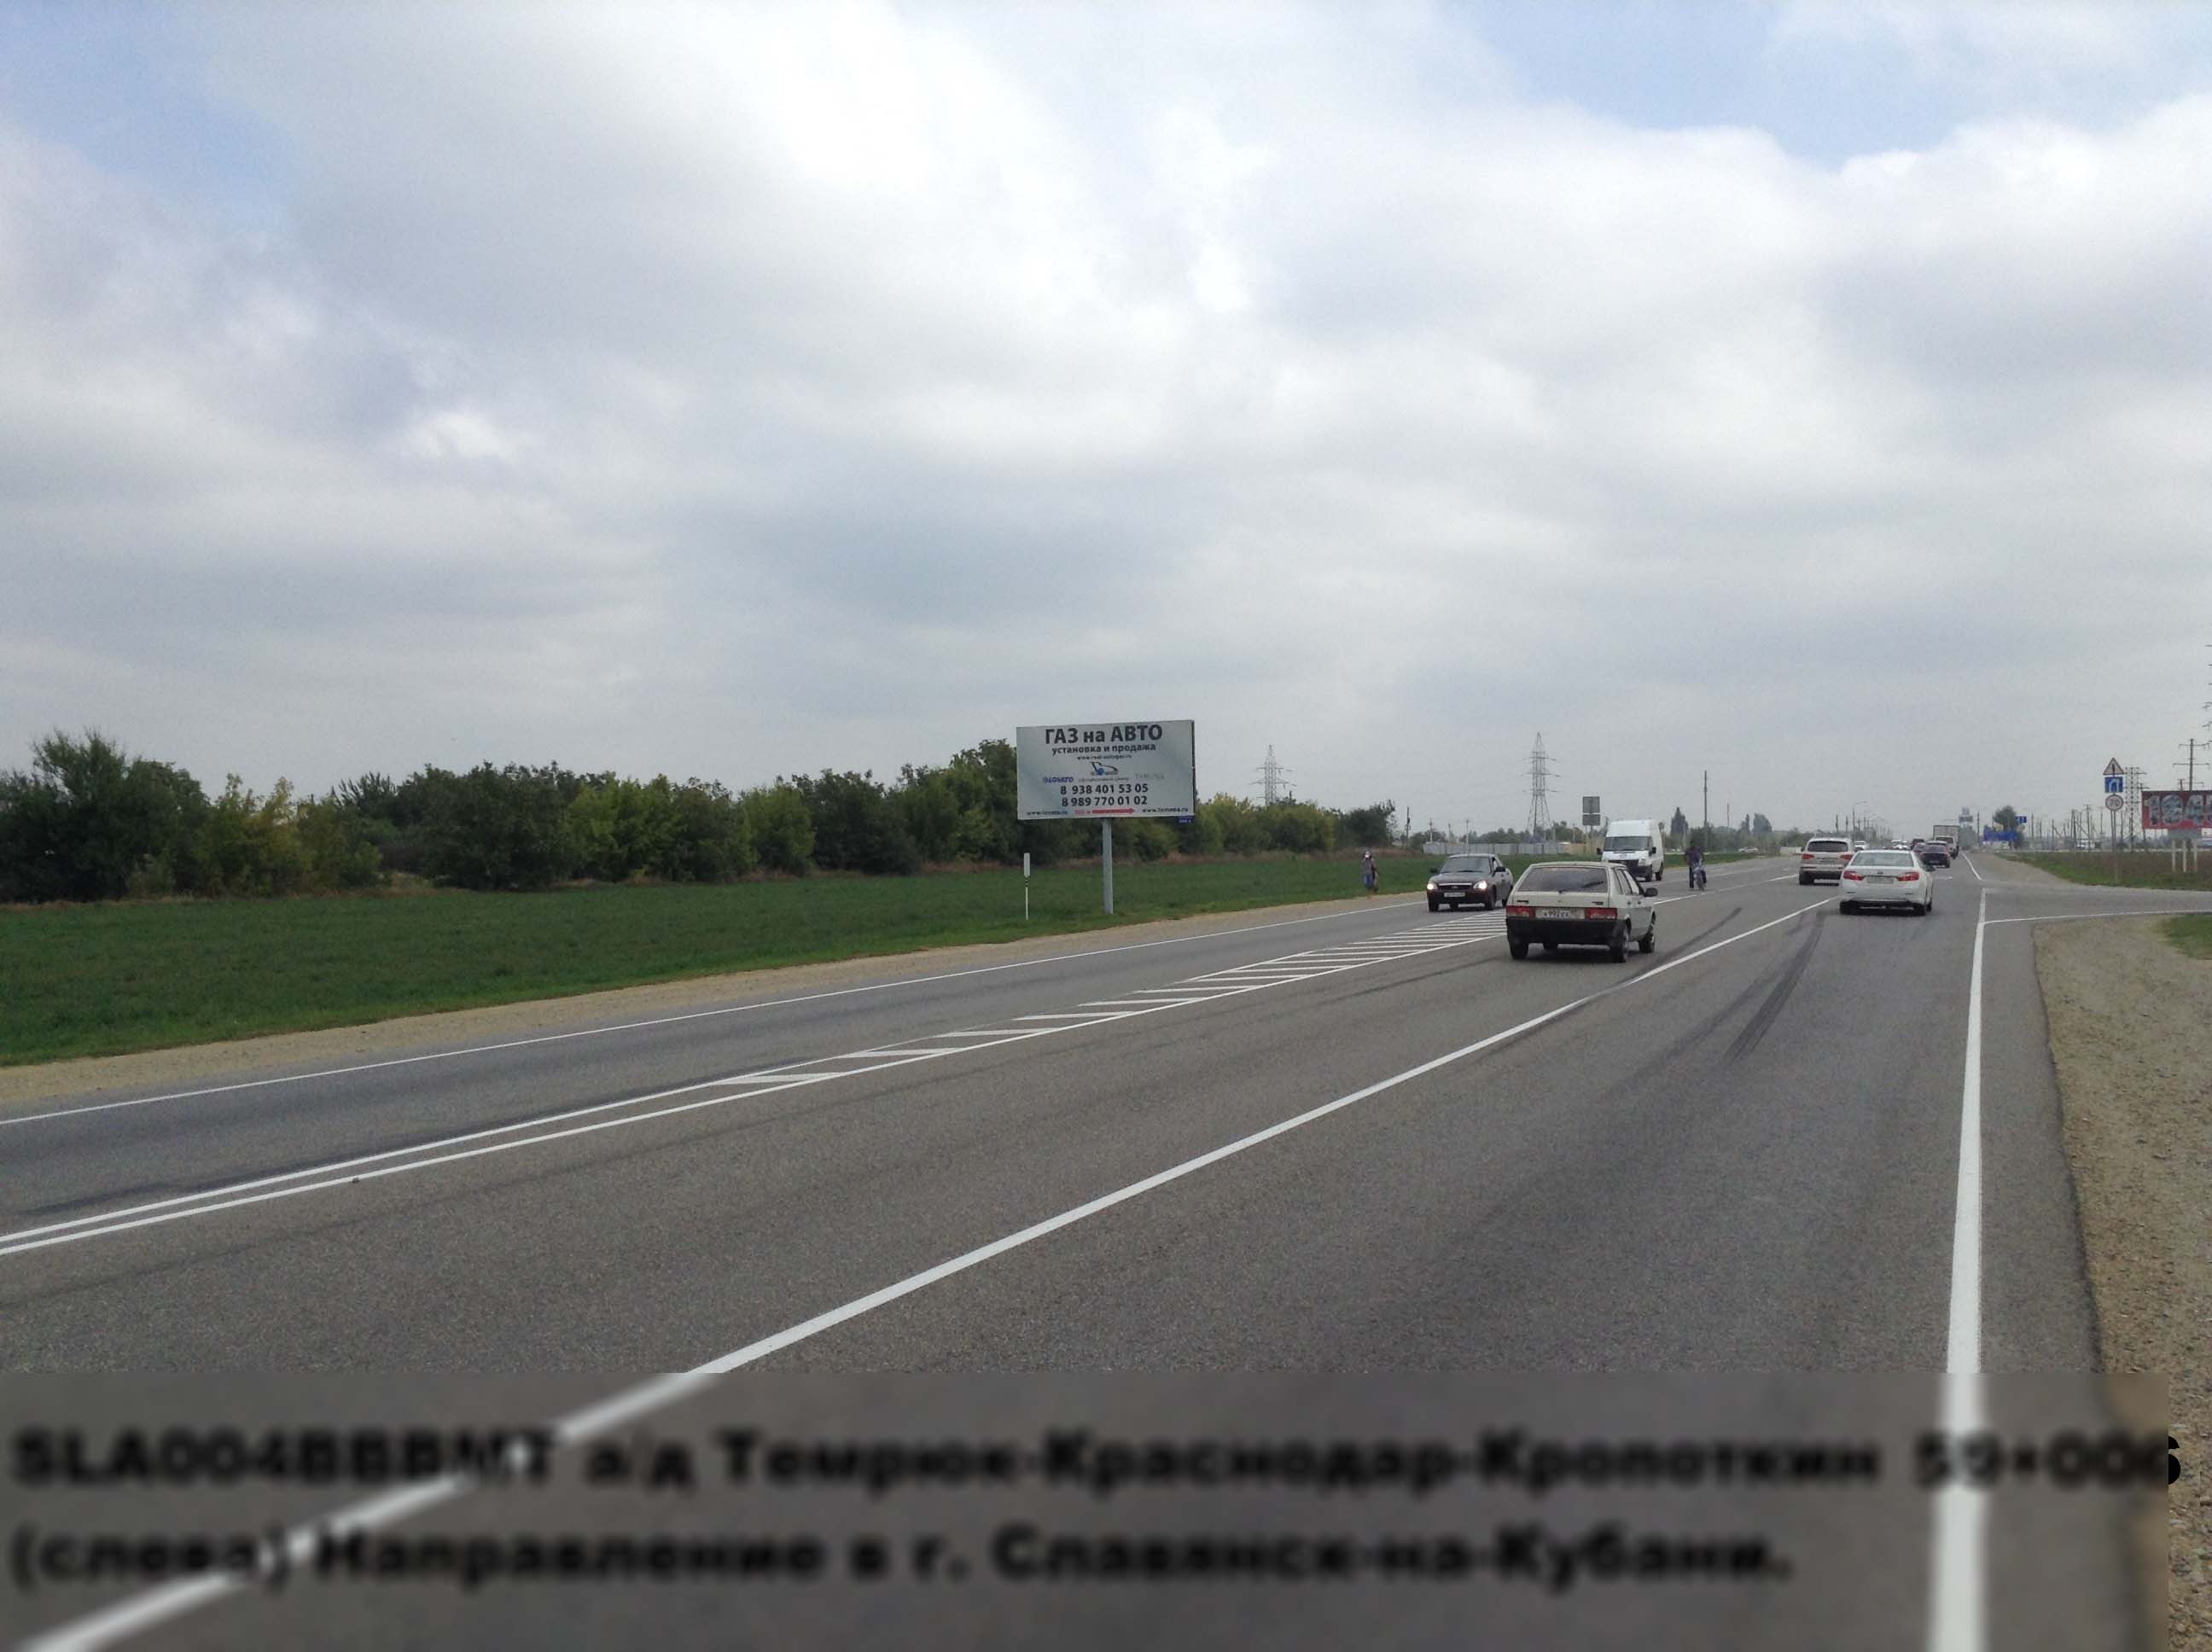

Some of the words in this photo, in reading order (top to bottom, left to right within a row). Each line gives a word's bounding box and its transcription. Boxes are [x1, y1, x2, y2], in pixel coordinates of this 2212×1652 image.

[1045, 728, 1078, 744] ГАЗ
[1084, 730, 1105, 742] на
[1110, 724, 1162, 742] АВТО
[1051, 746, 1101, 756] установка
[1112, 743, 1156, 754] продажа
[1060, 785, 1067, 795] 8
[1072, 785, 1092, 794] 938
[1096, 784, 1115, 794] 401
[1119, 783, 1132, 793] 53
[1134, 783, 1149, 793] 05
[1062, 797, 1068, 807] 8
[1071, 796, 1091, 806] 989
[1094, 796, 1115, 806] 770
[1117, 795, 1130, 806] 01
[1134, 795, 1148, 805] 02
